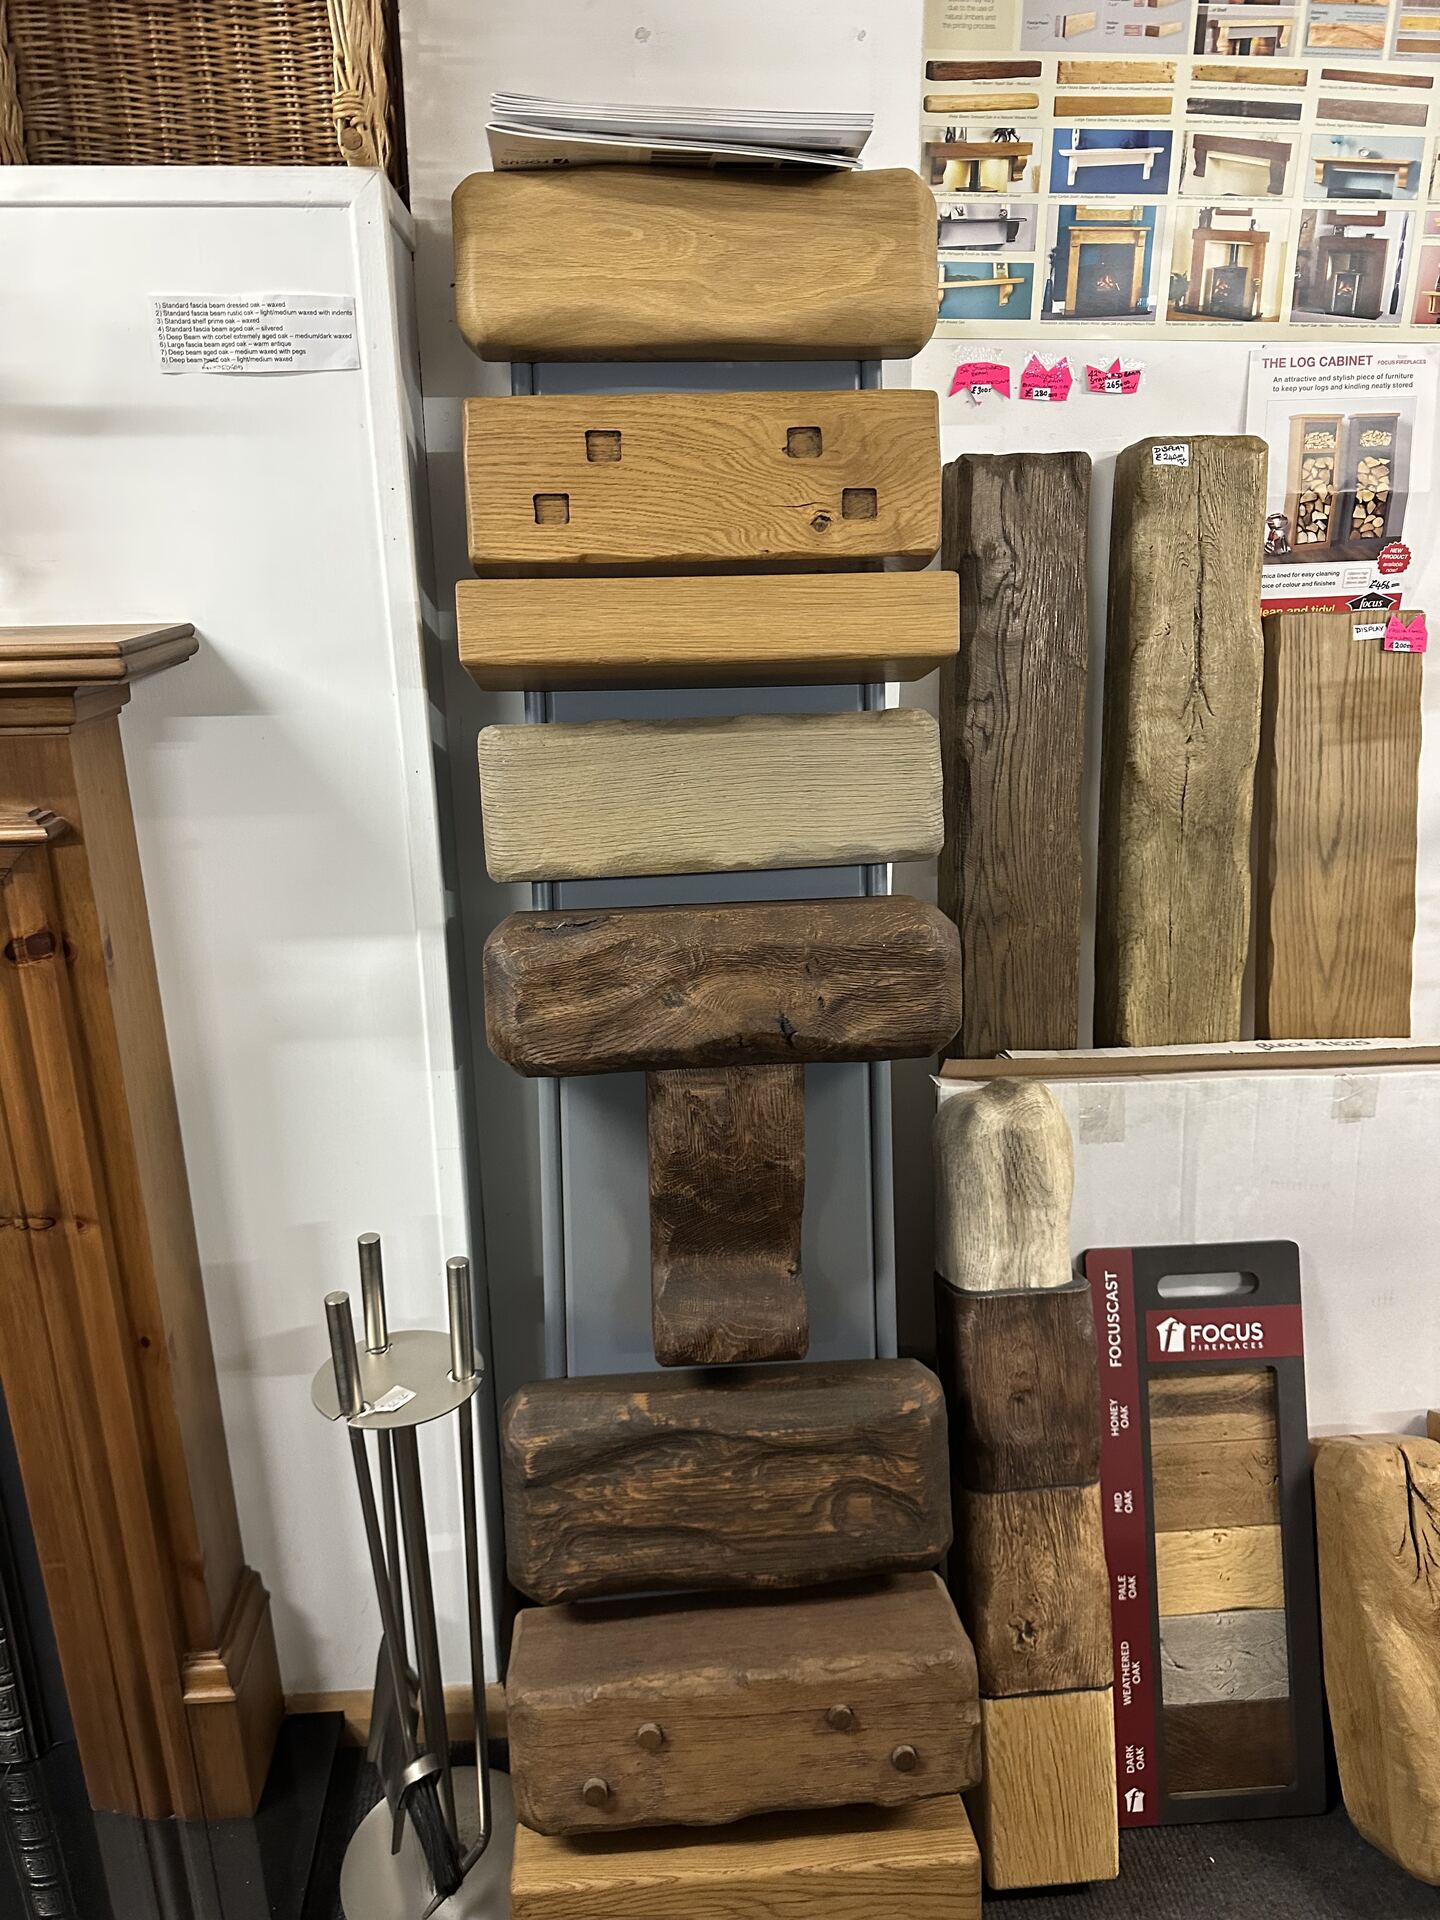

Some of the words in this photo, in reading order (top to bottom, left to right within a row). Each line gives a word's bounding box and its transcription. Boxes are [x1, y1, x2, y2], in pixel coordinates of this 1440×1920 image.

[1262, 358, 1286, 368] THE
[1290, 357, 1316, 368] LOG
[1320, 355, 1373, 367] CABINET
[1281, 385, 1297, 393] keep
[1333, 374, 1354, 382] stylish
[1359, 598, 1384, 610] focus
[1355, 626, 1384, 634] DISPLAY
[1104, 1270, 1122, 1368] FOCUSCAST
[1190, 1322, 1264, 1344] FOCUS
[1191, 1342, 1264, 1352] FIREPLACES
[1110, 1398, 1120, 1437] HONEY
[1120, 1406, 1130, 1429] OAK
[1114, 1492, 1122, 1513] MID
[1124, 1490, 1133, 1513] OAK
[1118, 1575, 1126, 1601] PALE
[1128, 1575, 1137, 1599] OAK
[1121, 1641, 1132, 1706] WEATHERED
[1132, 1660, 1141, 1685] OAK
[1126, 1744, 1135, 1774] DARK
[1136, 1746, 1145, 1770] OAK
